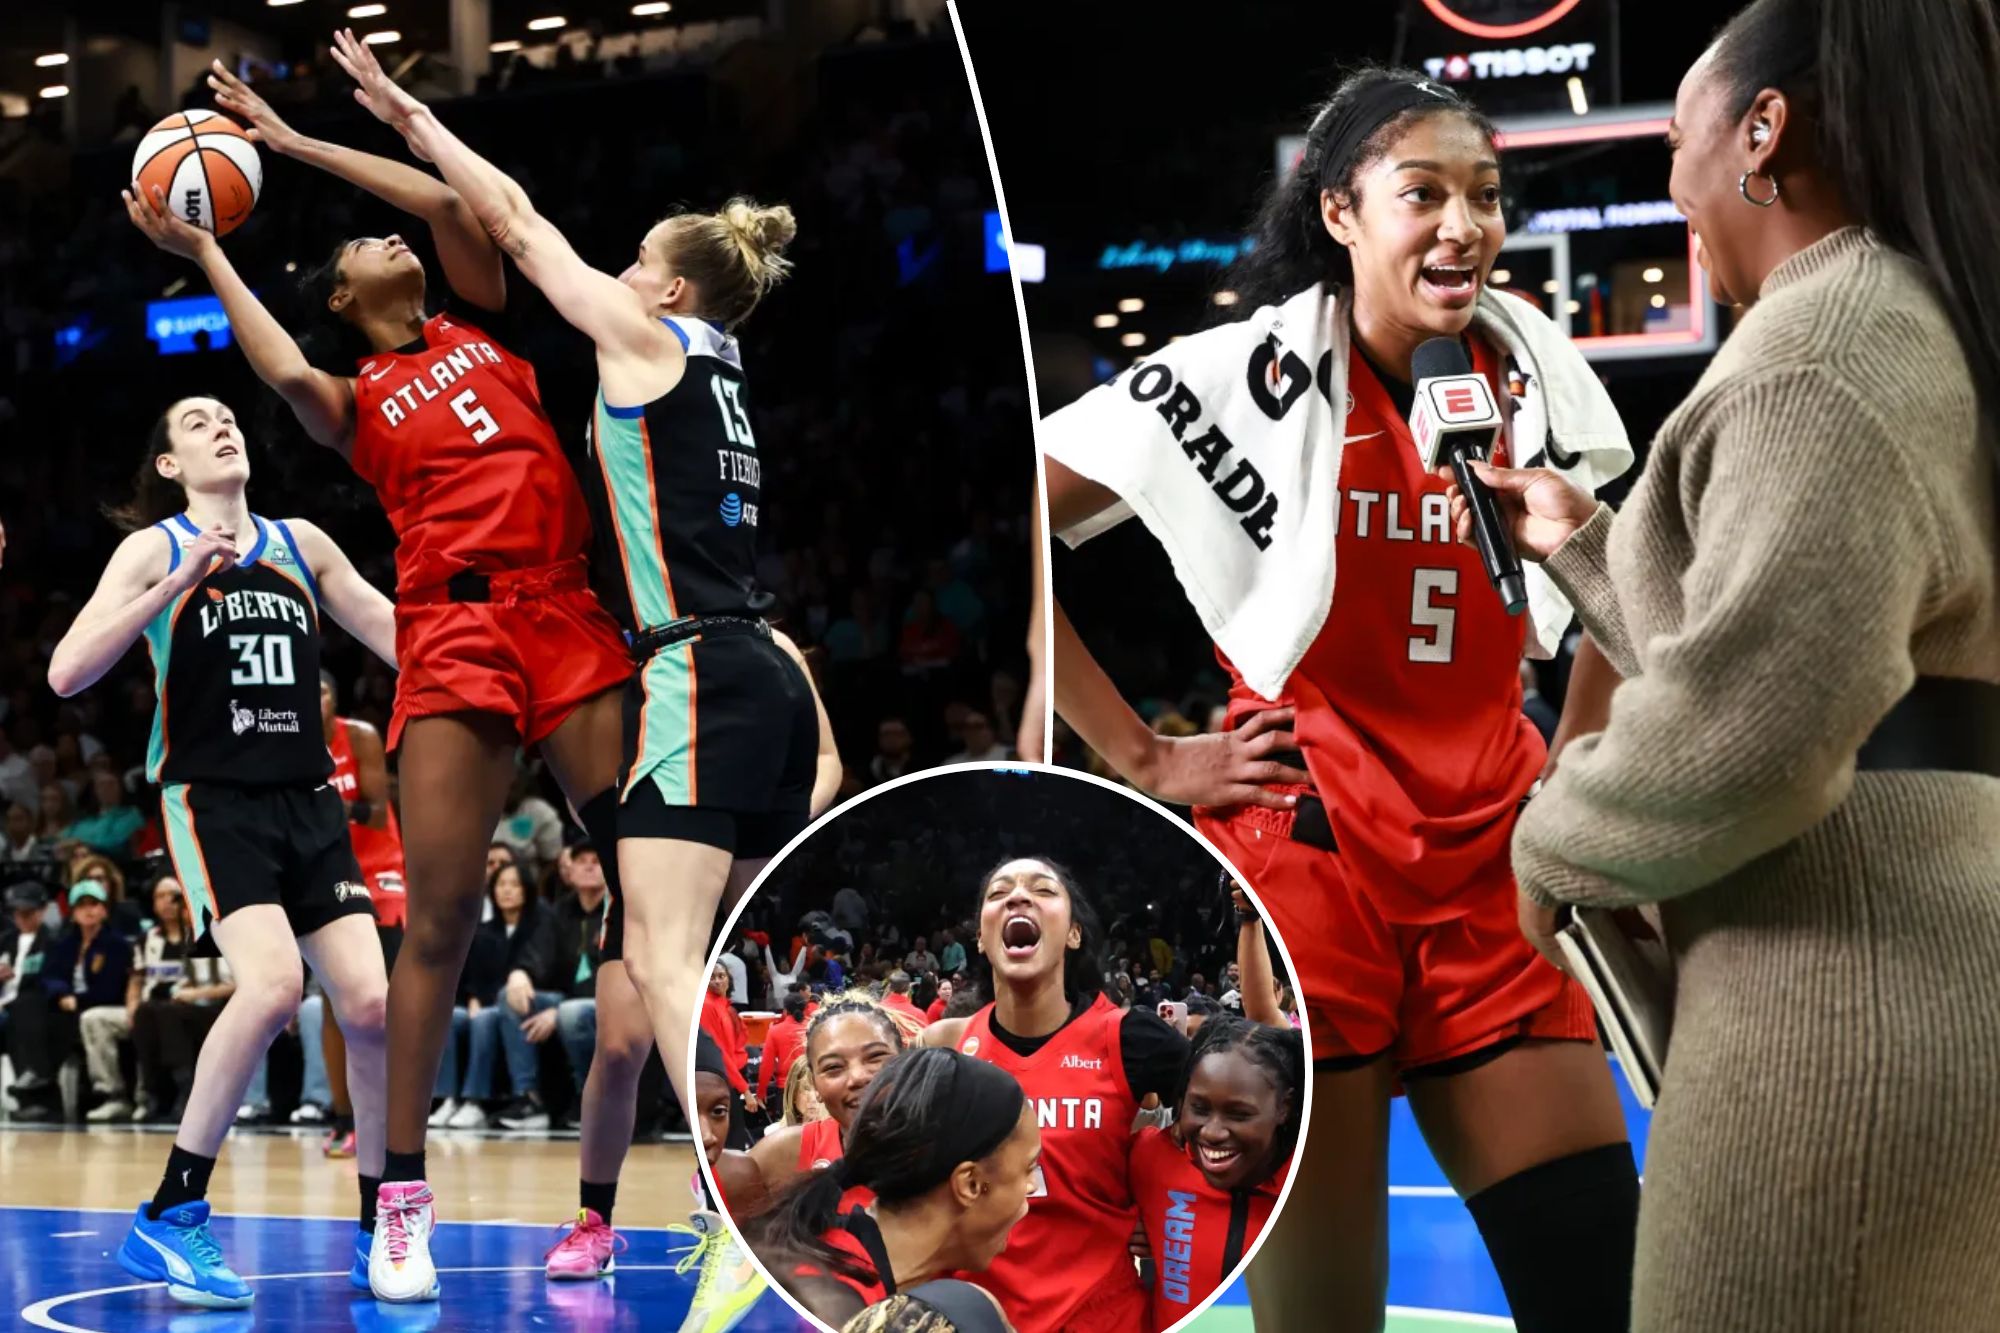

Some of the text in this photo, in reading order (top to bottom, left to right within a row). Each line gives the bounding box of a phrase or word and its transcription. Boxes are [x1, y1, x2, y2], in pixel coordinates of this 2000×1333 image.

[1468, 42, 1596, 79] TISSOT
[380, 341, 502, 428] ATLANTA
[449, 388, 501, 445] 5
[711, 374, 756, 449] 13
[742, 502, 759, 527] AT&
[1334, 488, 1451, 544] TLA
[200, 589, 309, 639] LIBERTY
[1408, 568, 1458, 663] 5
[229, 634, 295, 686] 30
[256, 719, 300, 733] Mutual
[258, 708, 298, 721] Liberty
[1060, 1054, 1102, 1070] Albert
[1028, 1098, 1102, 1129] NTA
[1163, 1189, 1198, 1305] DREAM
